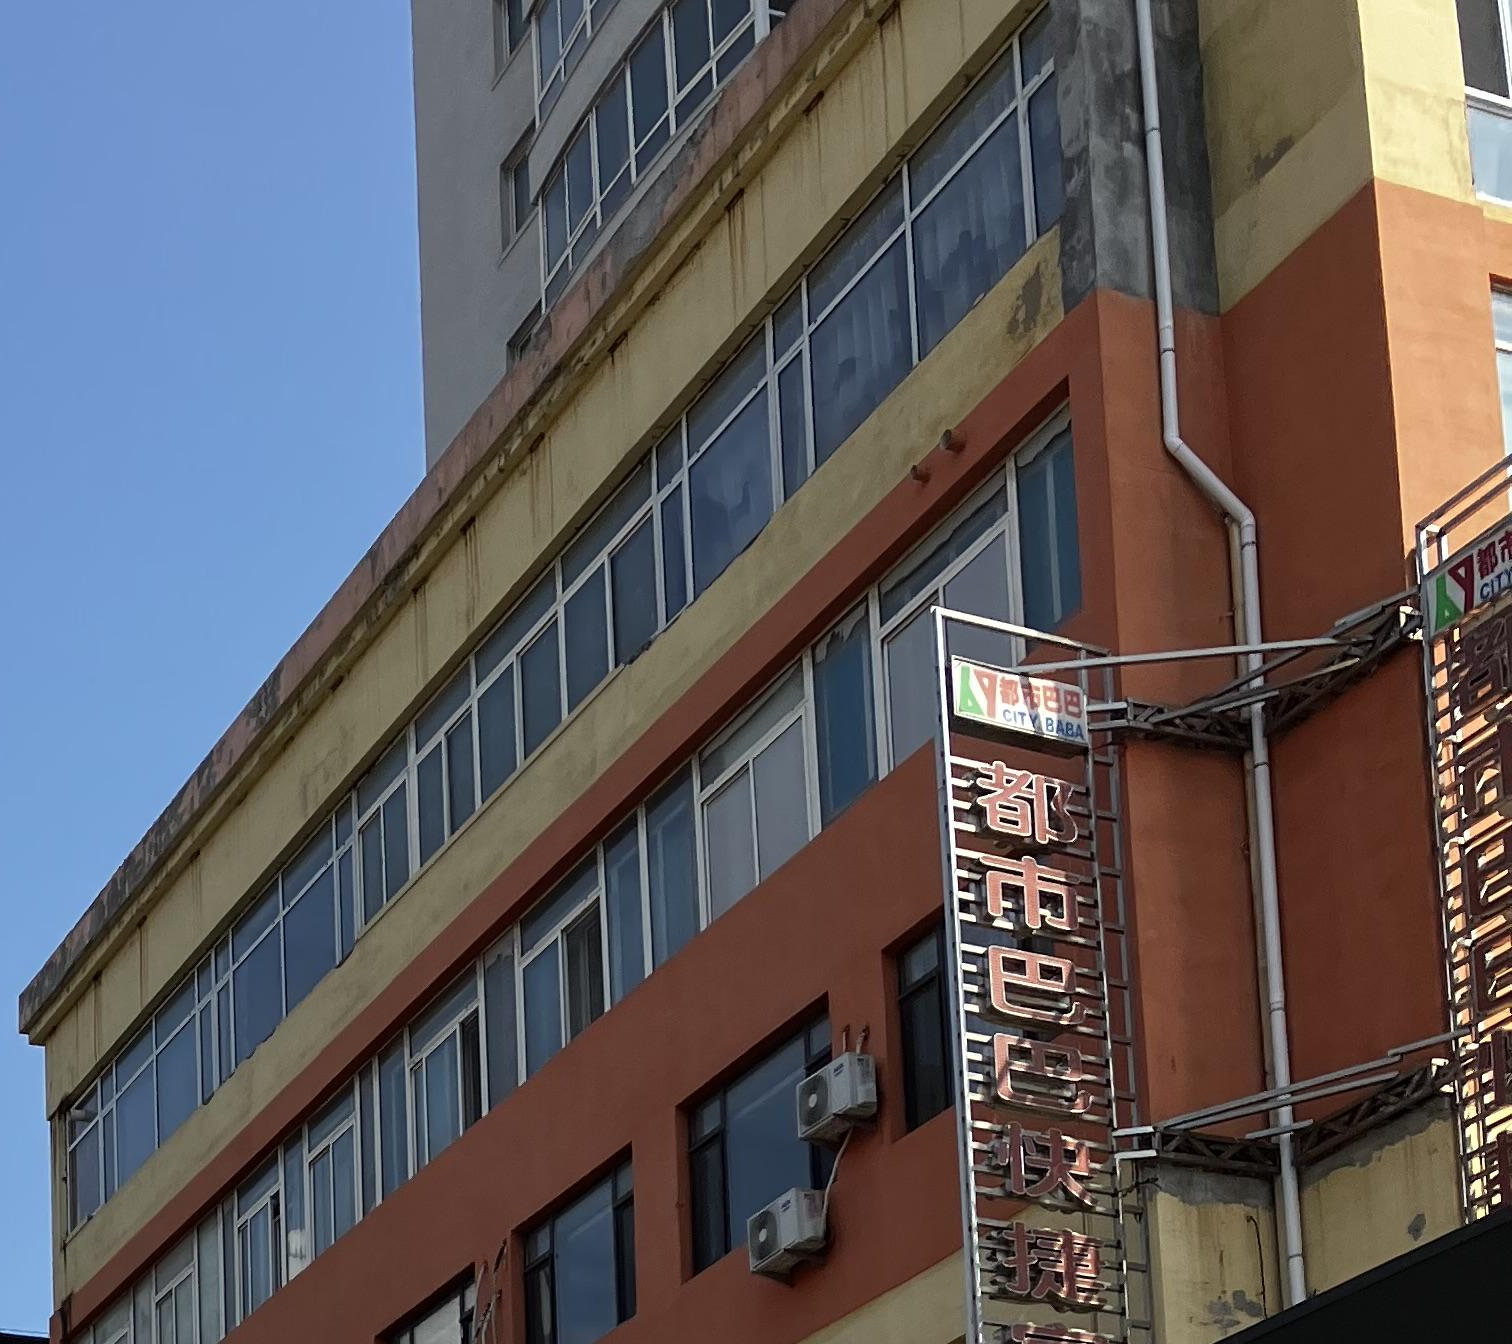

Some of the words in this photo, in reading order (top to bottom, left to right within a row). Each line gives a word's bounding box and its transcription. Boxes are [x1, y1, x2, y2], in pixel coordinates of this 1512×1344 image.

[999, 675, 1083, 720] 都市巴巴
[1002, 708, 1041, 730] CITY
[1045, 718, 1085, 741] BABA
